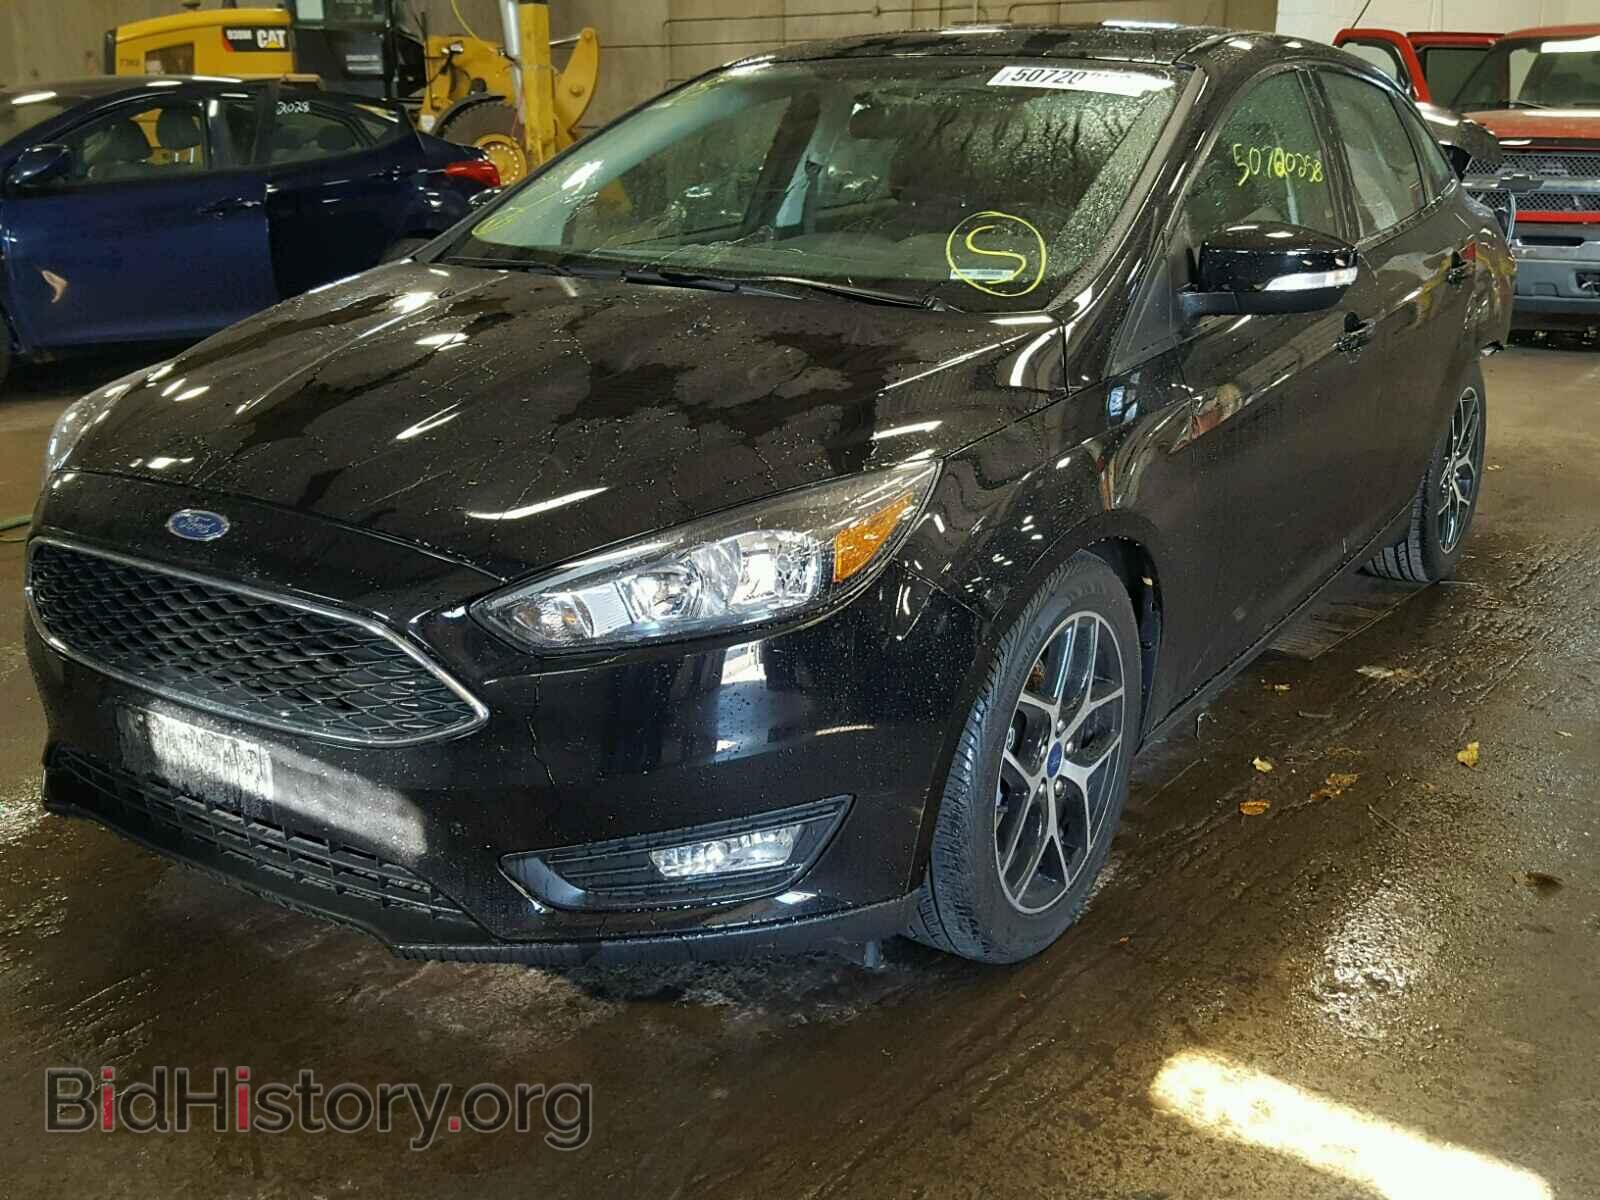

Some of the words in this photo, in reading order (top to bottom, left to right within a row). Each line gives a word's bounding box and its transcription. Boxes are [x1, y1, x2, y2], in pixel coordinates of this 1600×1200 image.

[257, 29, 286, 48] CAT
[276, 100, 310, 115] 2028
[965, 225, 1026, 284] S
